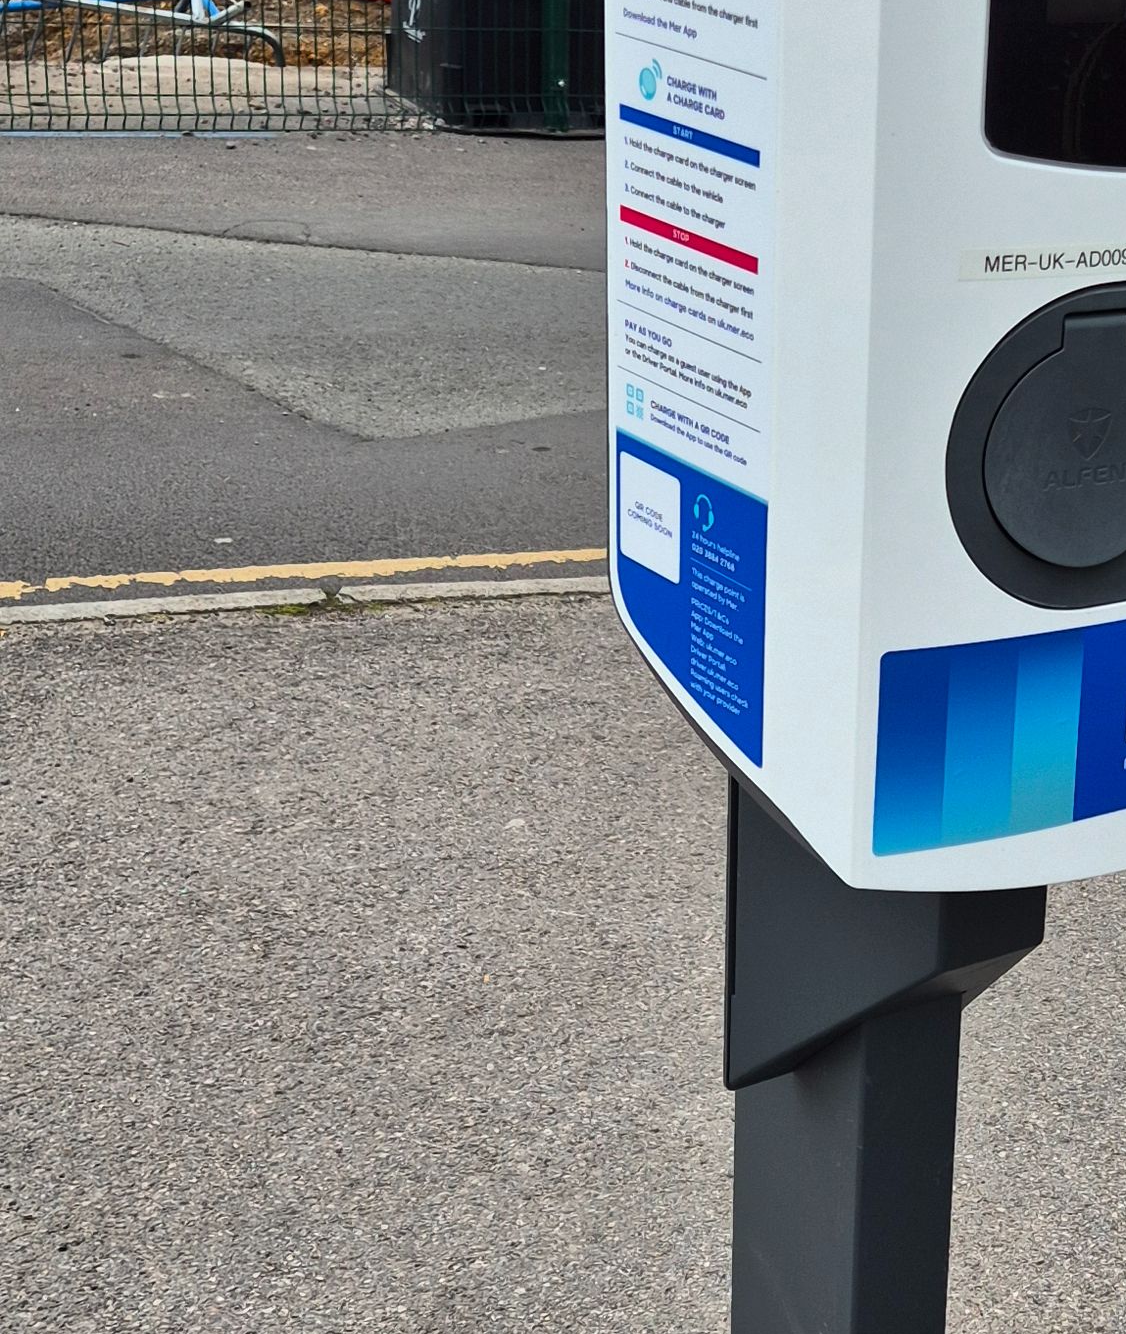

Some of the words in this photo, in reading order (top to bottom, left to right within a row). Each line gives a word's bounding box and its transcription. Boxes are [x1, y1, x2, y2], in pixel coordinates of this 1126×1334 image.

[656, 18, 668, 29] the
[667, 76, 697, 95] CHARGE
[698, 86, 717, 101] WITH
[667, 92, 672, 102] A
[673, 94, 703, 113] CHARGE
[704, 104, 725, 120] CARD
[673, 125, 693, 139] START
[673, 229, 689, 242] STOP
